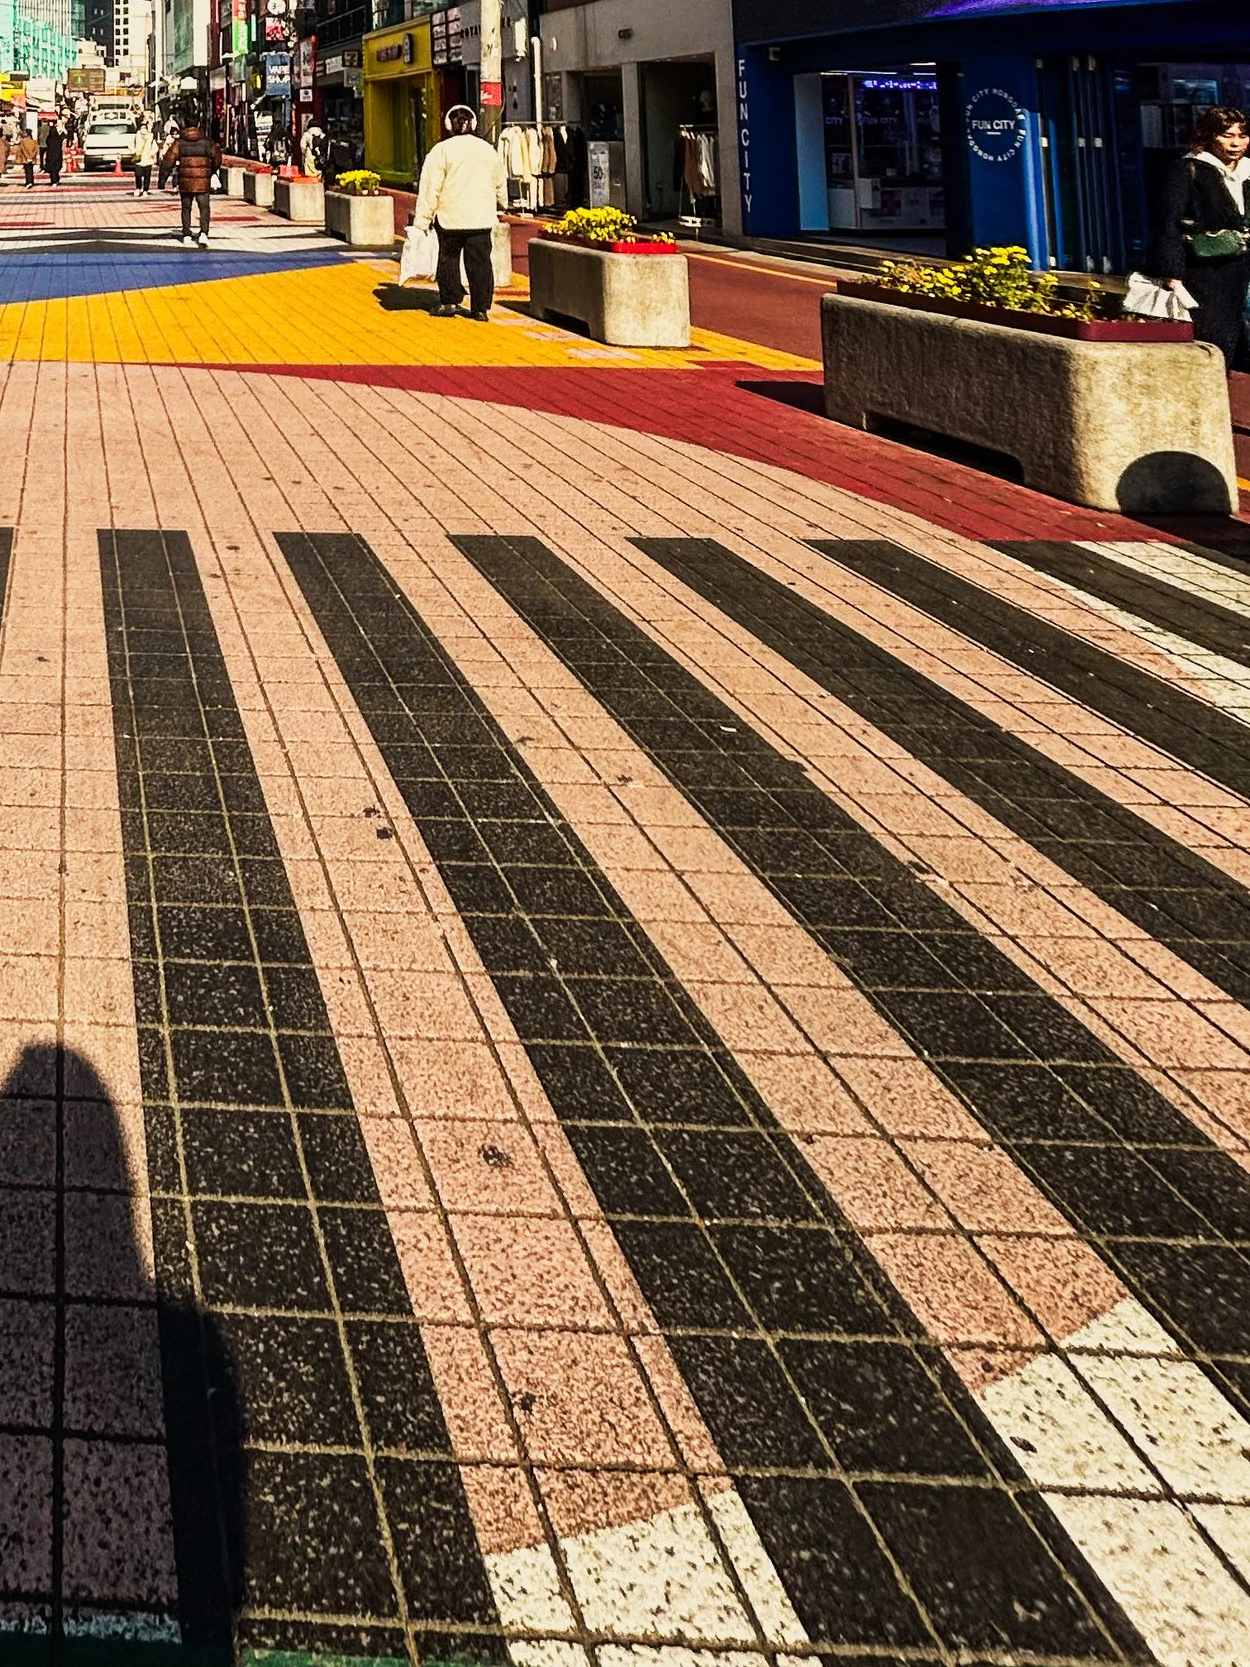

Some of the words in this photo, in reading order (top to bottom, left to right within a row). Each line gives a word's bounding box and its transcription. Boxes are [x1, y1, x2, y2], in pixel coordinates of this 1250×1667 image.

[268, 65, 291, 75] VAPE
[267, 74, 291, 84] SHOP
[738, 59, 748, 119] FUN
[971, 120, 992, 130] FUN
[992, 119, 1016, 130] CITY
[740, 128, 753, 214] CITY
